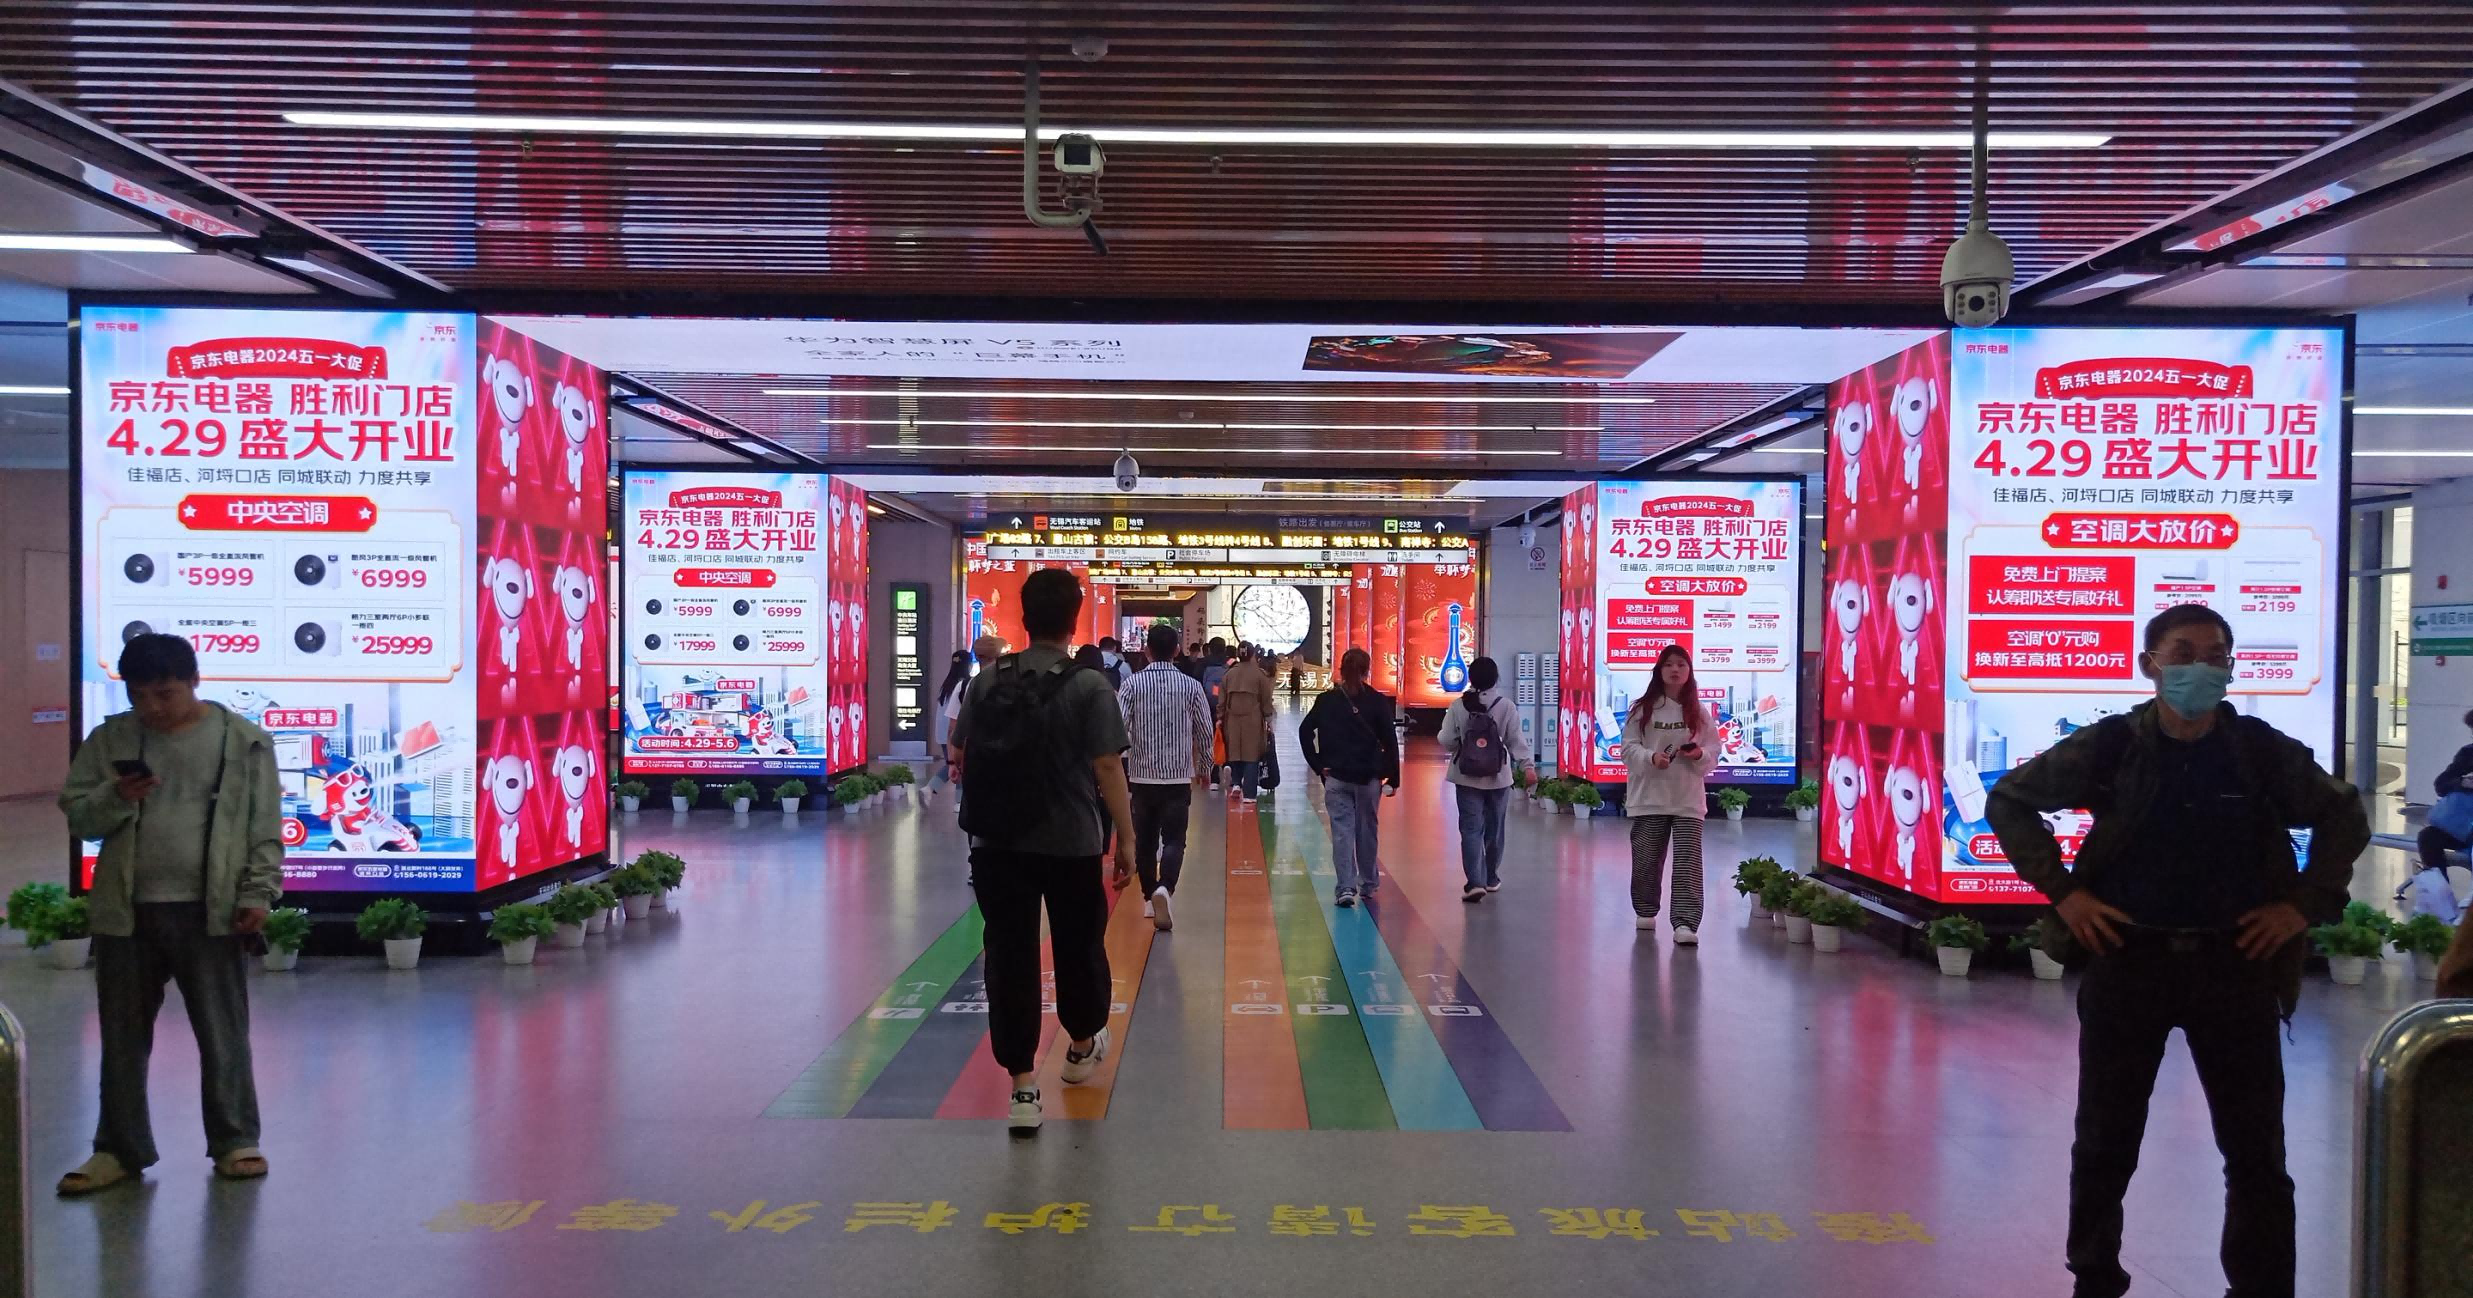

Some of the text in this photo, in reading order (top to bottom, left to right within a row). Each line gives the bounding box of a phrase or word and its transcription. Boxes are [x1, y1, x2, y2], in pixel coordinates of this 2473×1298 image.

[95, 322, 139, 332] 京东电器
[433, 325, 456, 335] 京东
[1966, 344, 2009, 354] 京东电器
[2300, 344, 2323, 353] 京东
[191, 348, 363, 372] 京东电器2024五一大促
[2057, 368, 2229, 391] 京东电器2024五一大促
[109, 381, 453, 417] 京东电器 胜利门店
[1977, 402, 2318, 436] 京东电器 胜利门店
[107, 418, 454, 462] 4.29 盛大开业
[1973, 438, 2318, 480] 4.29 盛大开业
[127, 466, 432, 487] 佳福店、河埒口店 同城联动 力度共享
[681, 492, 770, 505] 京东电器2024五一大促
[1993, 487, 2294, 504] 佳福店、河埒口店 同城联动 力度共享
[227, 501, 329, 526] 中央空调
[1653, 501, 1742, 513] 京东电器2024五一大促
[639, 509, 816, 528] 京东电器 胜利门店
[1399, 521, 1421, 529] 公交站
[1611, 519, 1788, 537] 京东电器 胜利门店
[2070, 519, 2217, 544] 空调大放价
[637, 529, 816, 551] 4.29 盛大开业
[1609, 537, 1788, 560] 4.29 盛大开业
[699, 571, 752, 584] 中央空调
[2003, 565, 2107, 584] 免费上门提案
[1660, 579, 1736, 593] 空调大放价
[1986, 588, 2124, 607] 认筹即送专属好礼
[2259, 601, 2296, 612] 2199
[2006, 630, 2100, 647] 空调“0”元购
[1975, 651, 2126, 668] 换新至高抵1200元
[2256, 668, 2293, 679] 3999
[719, 681, 754, 689] 京东电器
[268, 711, 335, 726] 京东电器
